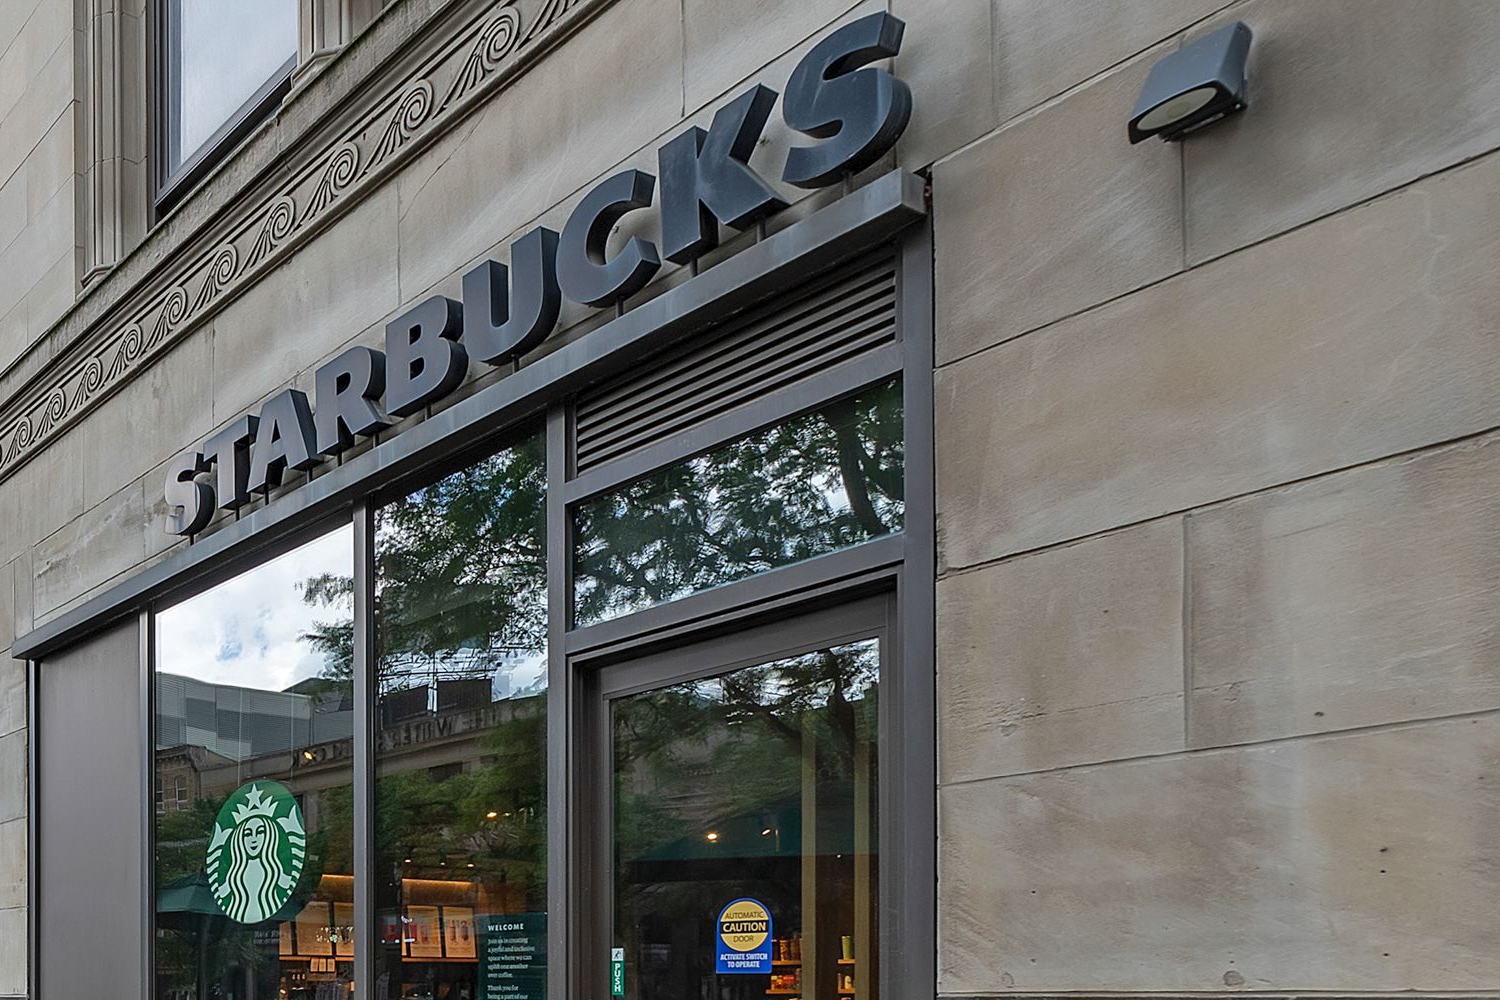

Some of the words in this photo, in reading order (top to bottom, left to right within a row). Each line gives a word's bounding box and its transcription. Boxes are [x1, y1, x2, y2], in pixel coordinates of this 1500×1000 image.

[163, 10, 913, 537] STARBUCKS
[725, 911, 764, 919] AUTOMATIC
[487, 923, 524, 931] WELCOME
[723, 922, 766, 932] CAUTION
[733, 935, 754, 943] DOOR
[720, 953, 745, 961] ACTIVATE
[746, 953, 768, 961] SWITCH
